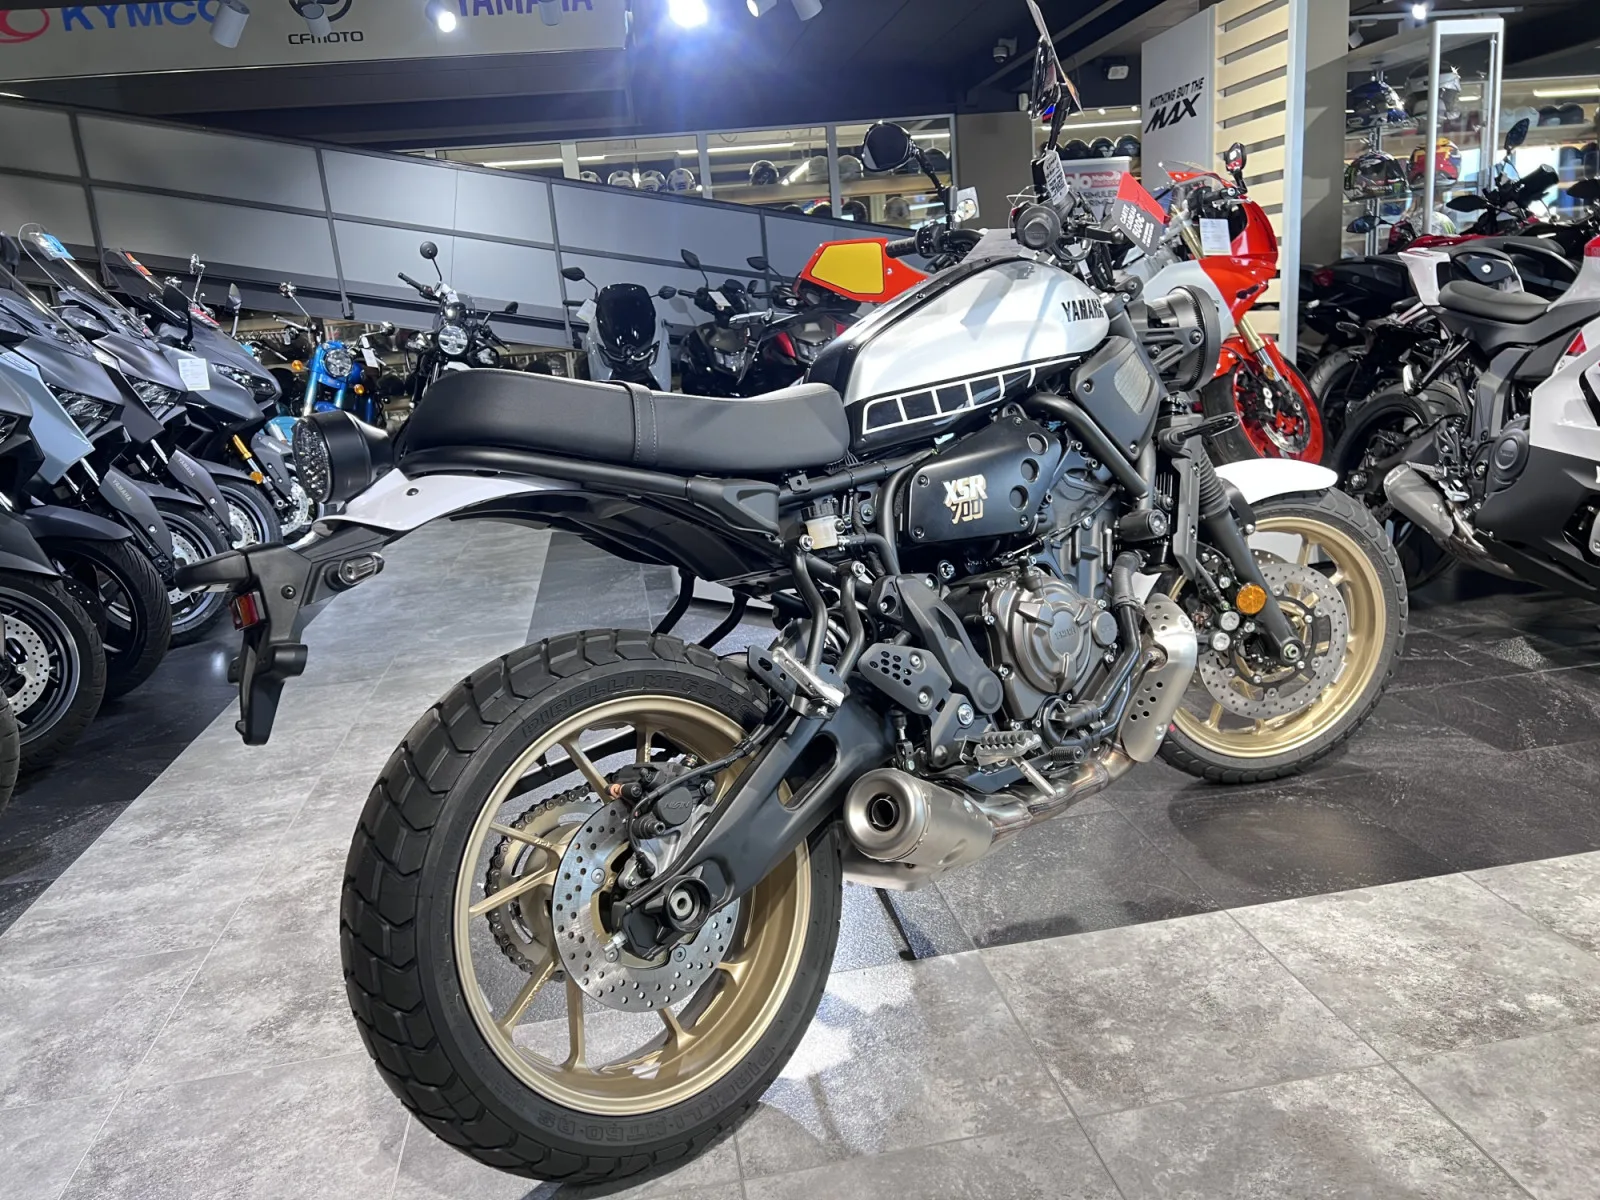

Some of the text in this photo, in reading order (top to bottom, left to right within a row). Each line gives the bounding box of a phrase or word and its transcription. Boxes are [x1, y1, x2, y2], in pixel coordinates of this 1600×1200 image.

[458, 0, 593, 17] YAMA
[1176, 83, 1191, 99] BUT
[1191, 77, 1205, 93] THE
[1144, 92, 1202, 134] MAX
[112, 479, 133, 502] YAMAHA
[942, 474, 988, 507] XSR
[950, 499, 984, 524] 700
